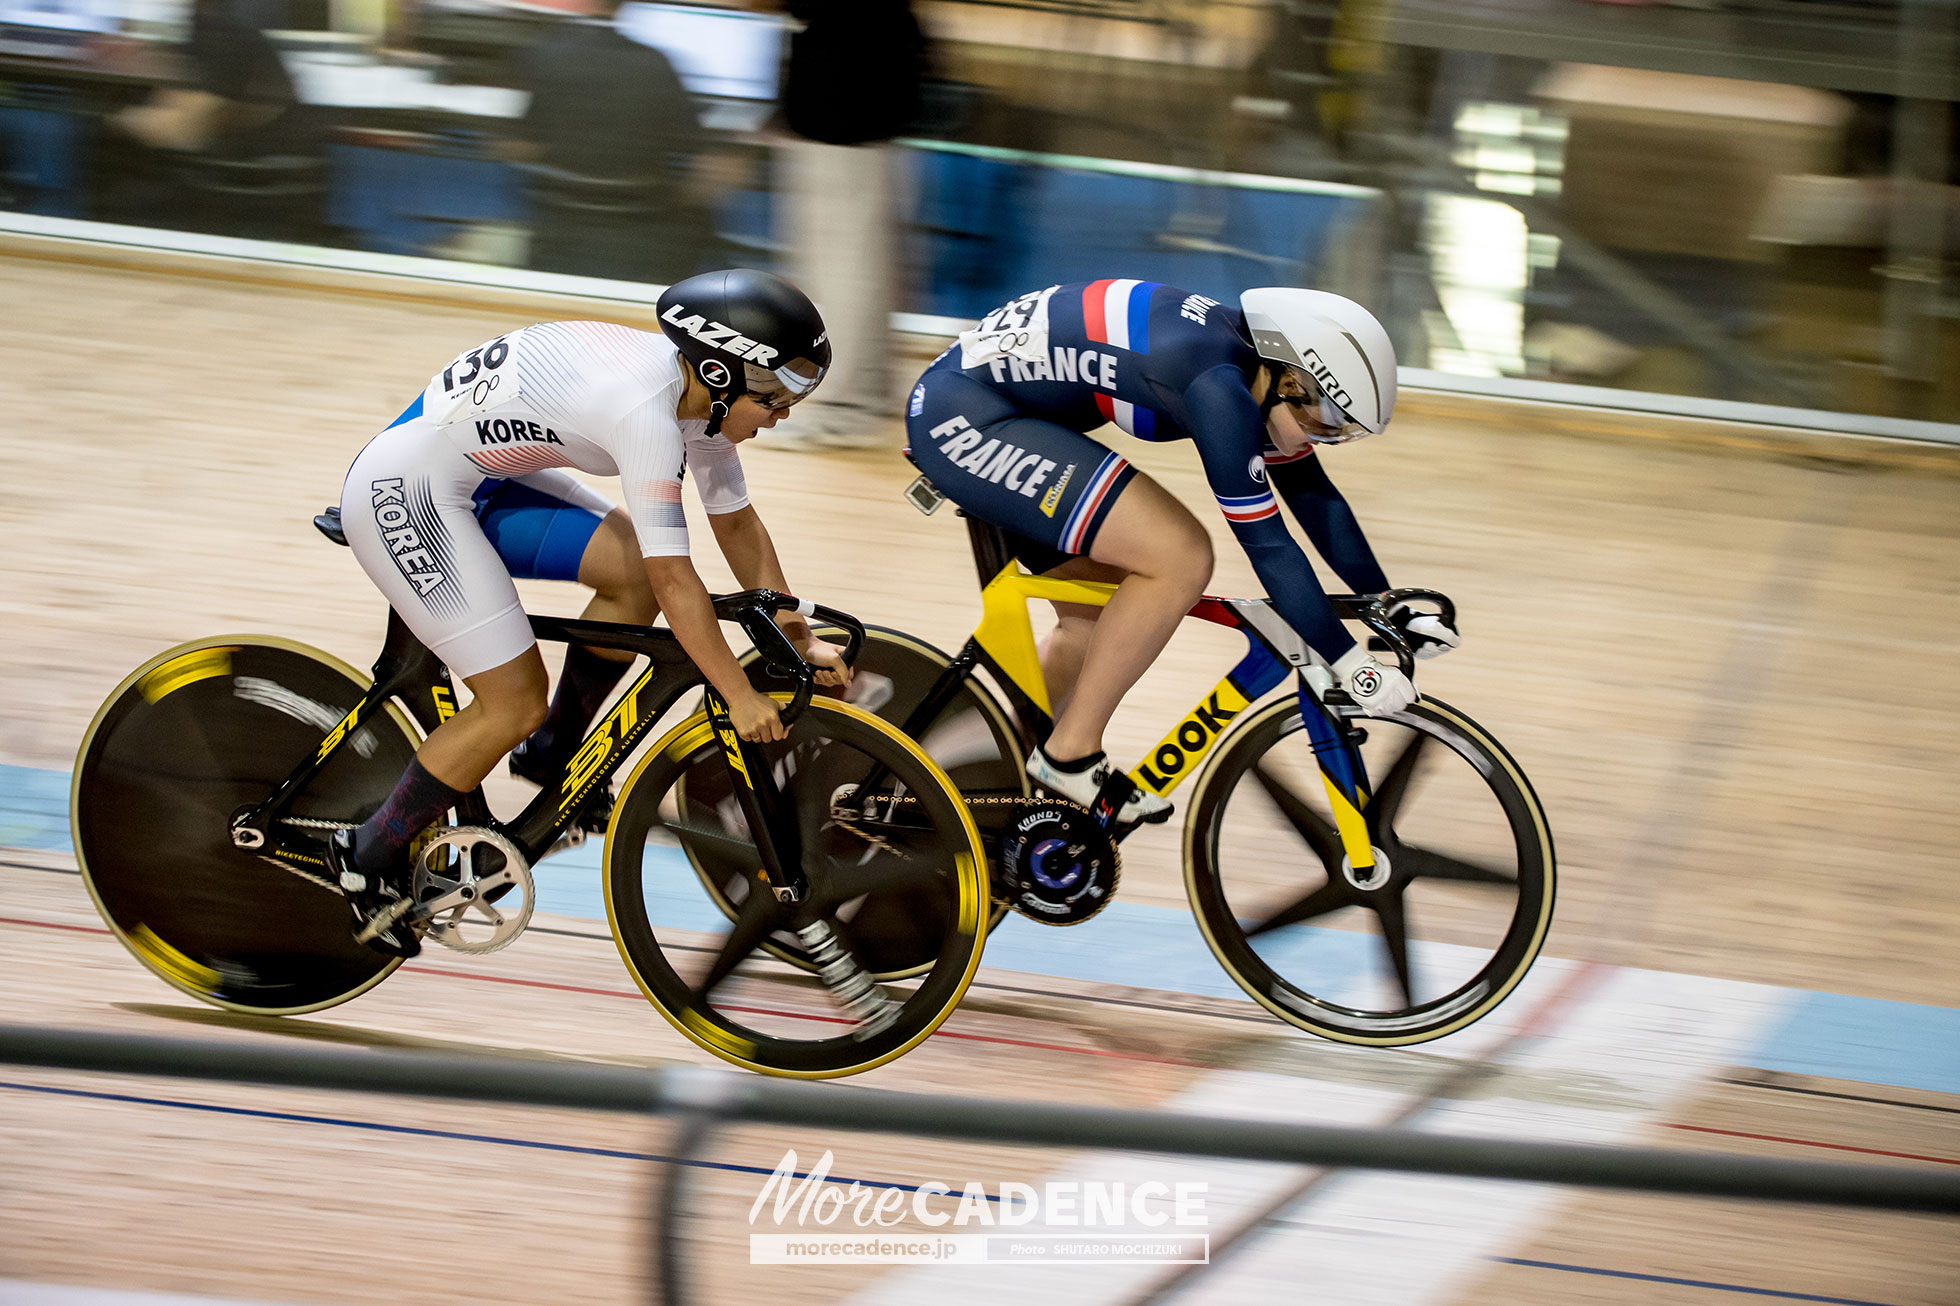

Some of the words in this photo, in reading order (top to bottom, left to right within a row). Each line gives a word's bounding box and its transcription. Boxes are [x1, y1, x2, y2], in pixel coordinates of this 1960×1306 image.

[661, 304, 779, 367] LAZER
[988, 346, 1118, 391] FRANCE
[1303, 348, 1353, 409] GIRO
[475, 419, 565, 447] KOREA
[929, 415, 1058, 498] FRANCE
[372, 478, 446, 597] KOREA
[555, 809, 571, 827] BIKE
[571, 752, 620, 807] TECHNOLOGIES
[621, 710, 656, 750] AUSTRALIA
[1138, 691, 1240, 792] LOOK
